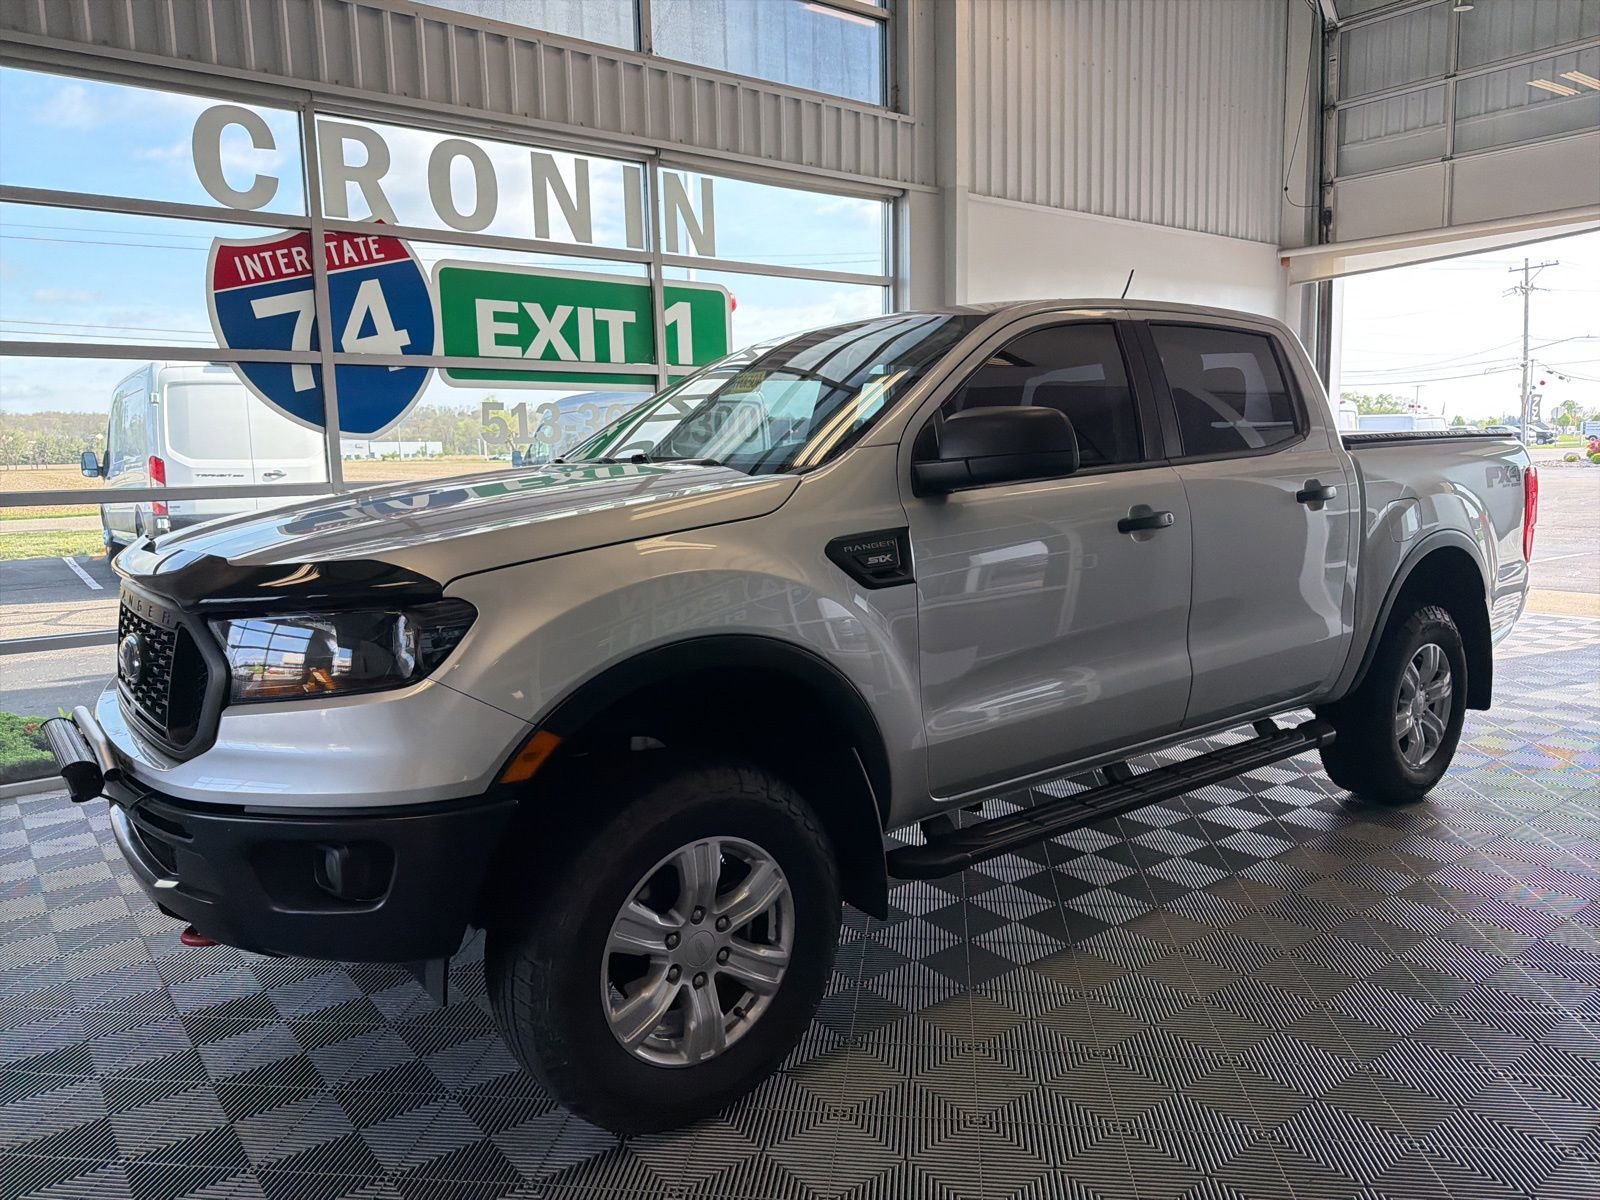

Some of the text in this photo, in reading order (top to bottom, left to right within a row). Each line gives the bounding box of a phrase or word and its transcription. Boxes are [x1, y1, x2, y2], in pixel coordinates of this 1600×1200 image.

[192, 104, 716, 257] CRONIN
[234, 236, 385, 282] INTERTATE
[250, 278, 411, 392] 74
[475, 298, 693, 364] EXIT 1
[843, 540, 894, 553] RANGER
[867, 553, 893, 564] STX
[122, 589, 171, 625] ANGER
